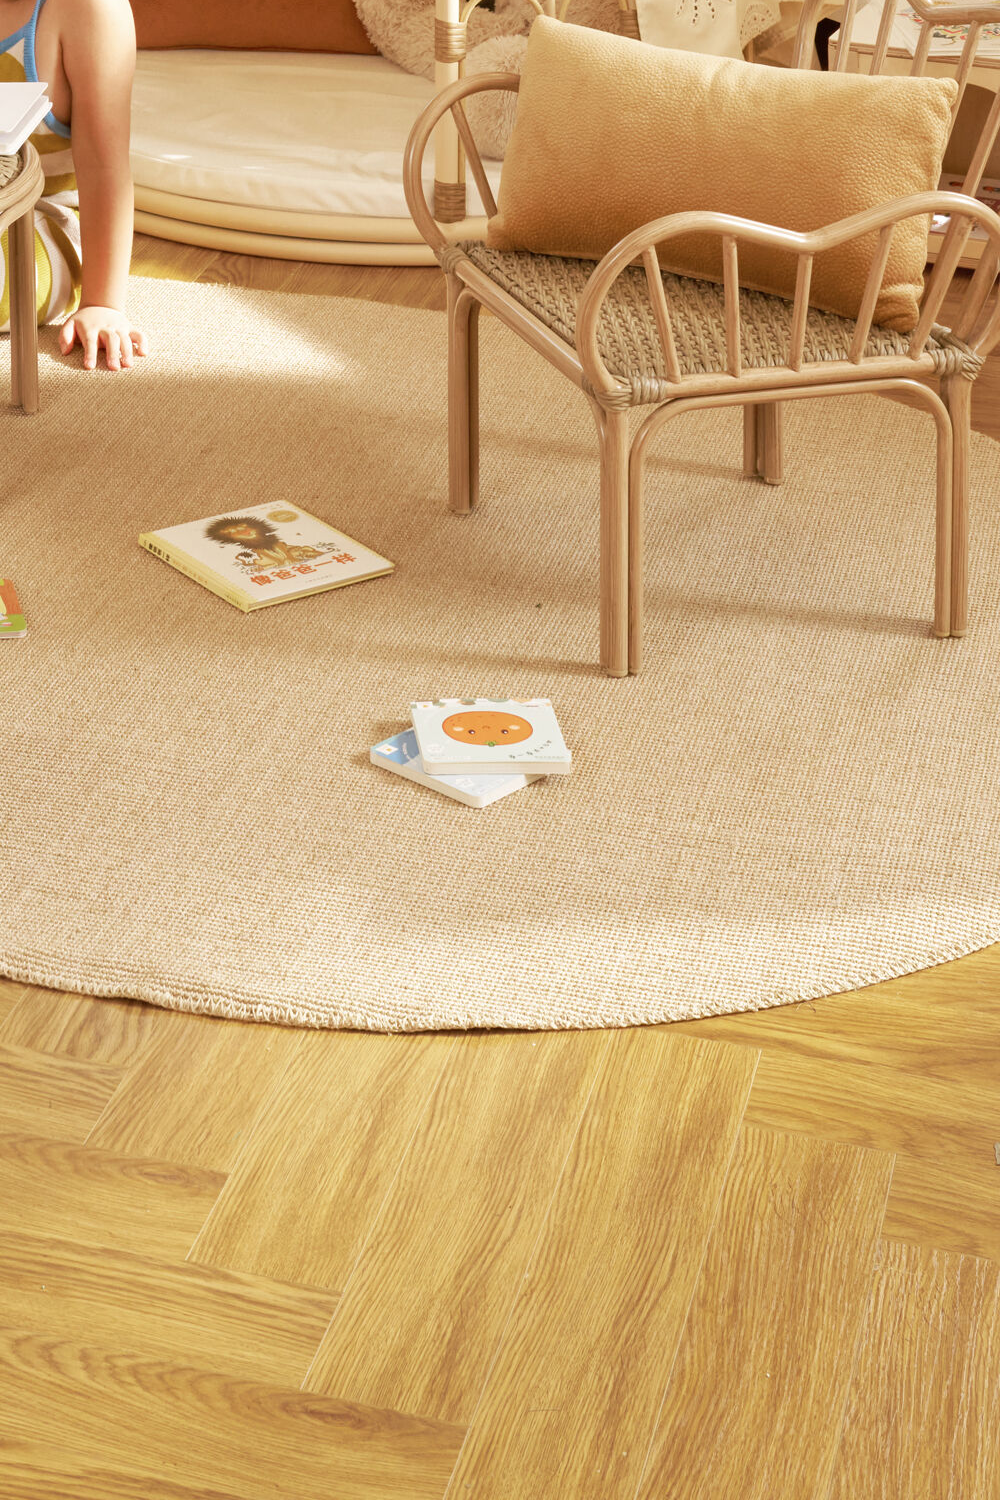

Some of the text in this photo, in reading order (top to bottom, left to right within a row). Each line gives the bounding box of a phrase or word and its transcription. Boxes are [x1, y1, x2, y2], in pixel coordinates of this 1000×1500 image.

[249, 552, 357, 587] 像爸爸一样
